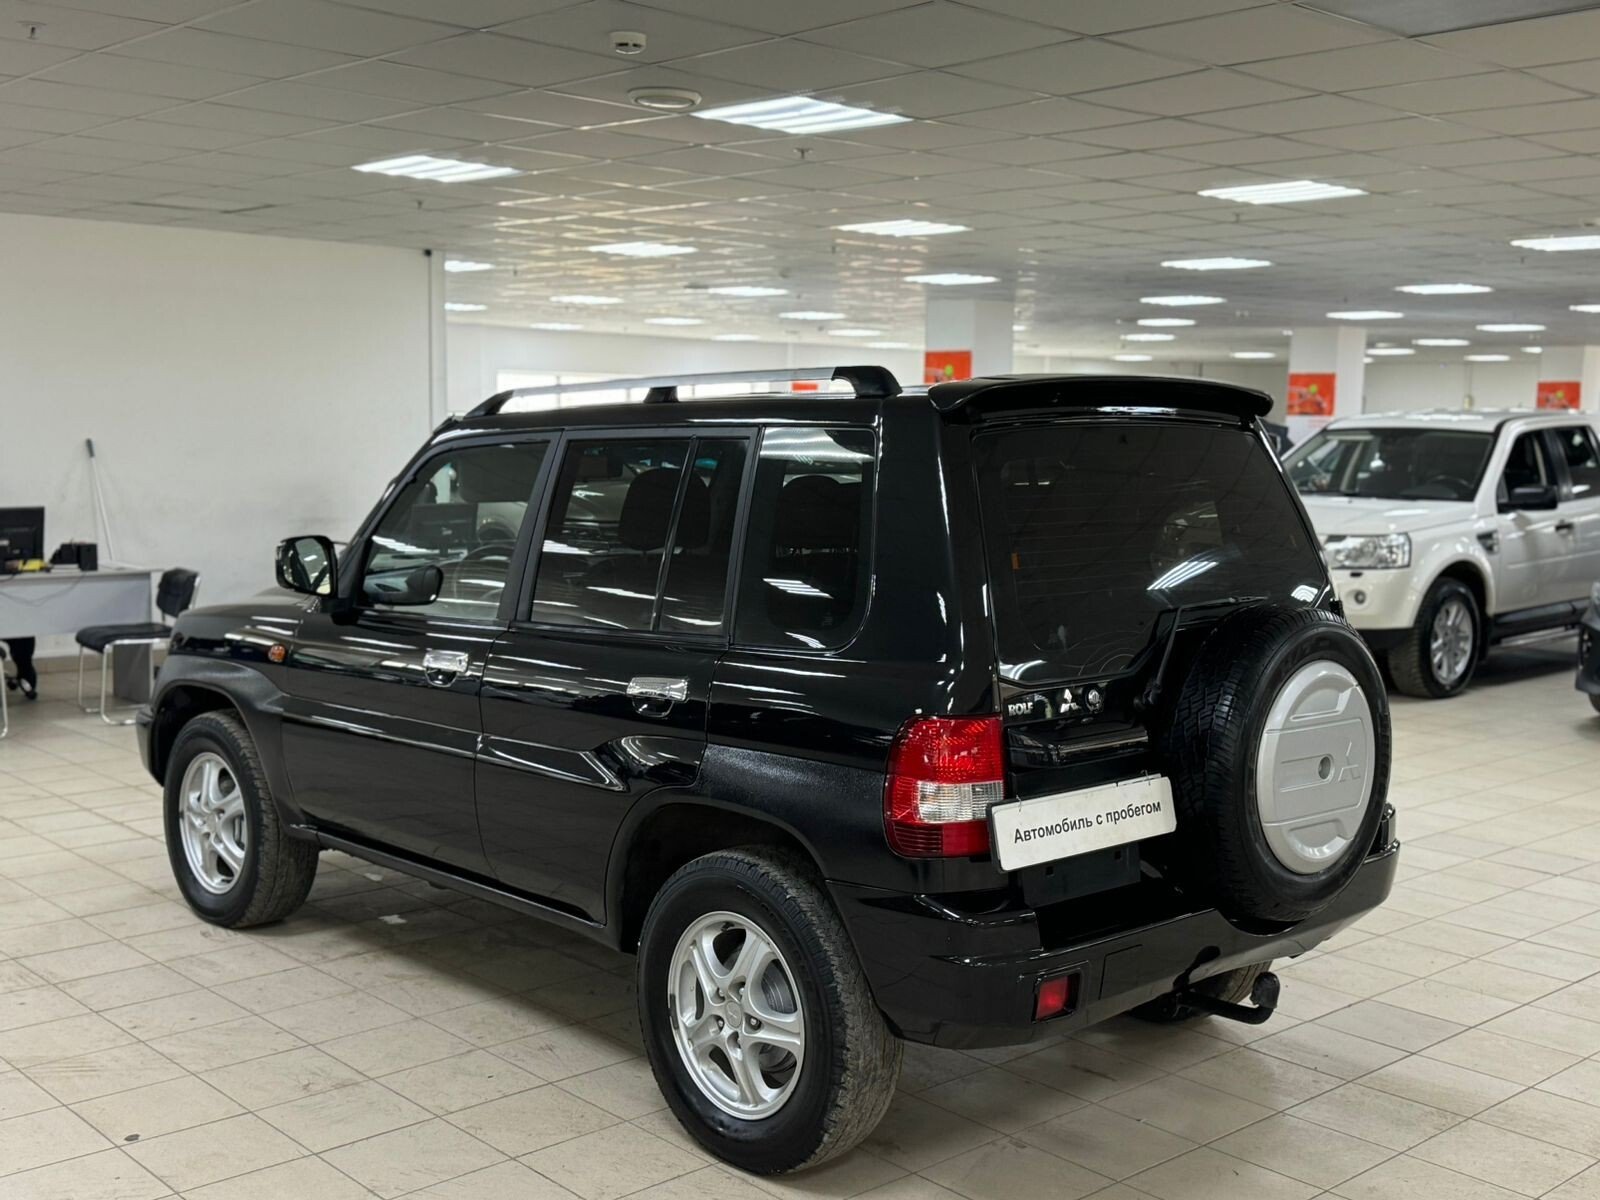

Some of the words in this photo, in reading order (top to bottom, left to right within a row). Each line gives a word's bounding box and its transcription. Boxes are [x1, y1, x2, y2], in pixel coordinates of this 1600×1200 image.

[1008, 702, 1033, 716] ROLF
[1014, 818, 1093, 843] Автомобиль
[1096, 813, 1103, 825] с
[1106, 801, 1162, 825] пробегом
